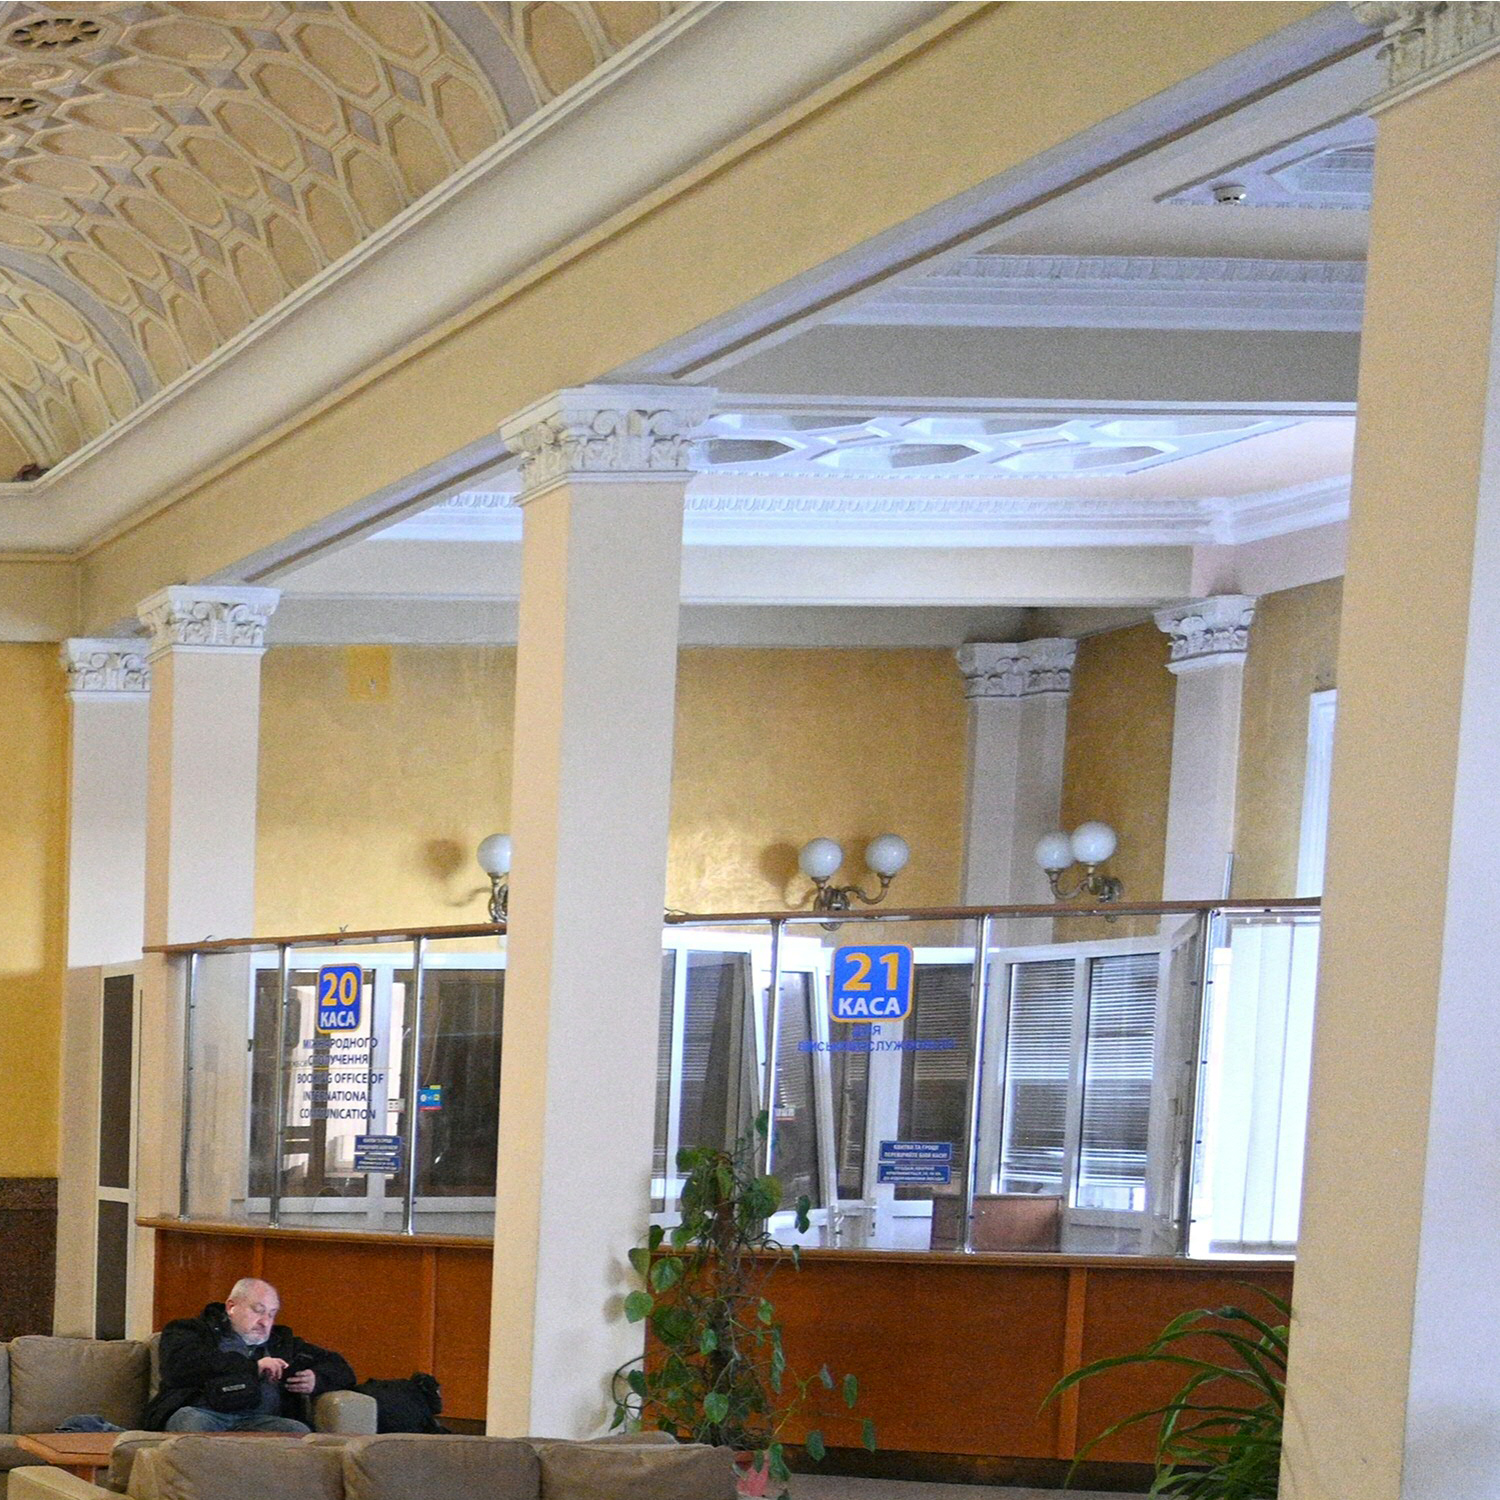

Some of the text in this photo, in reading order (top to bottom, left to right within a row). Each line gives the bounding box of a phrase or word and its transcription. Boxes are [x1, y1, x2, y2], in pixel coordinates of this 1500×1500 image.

[842, 952, 900, 991] 21
[322, 972, 358, 1006] 20
[838, 997, 900, 1016] КАСА
[320, 1011, 356, 1028] КАСА
[334, 1073, 367, 1084] OFFICE
[371, 1073, 384, 1084] OF
